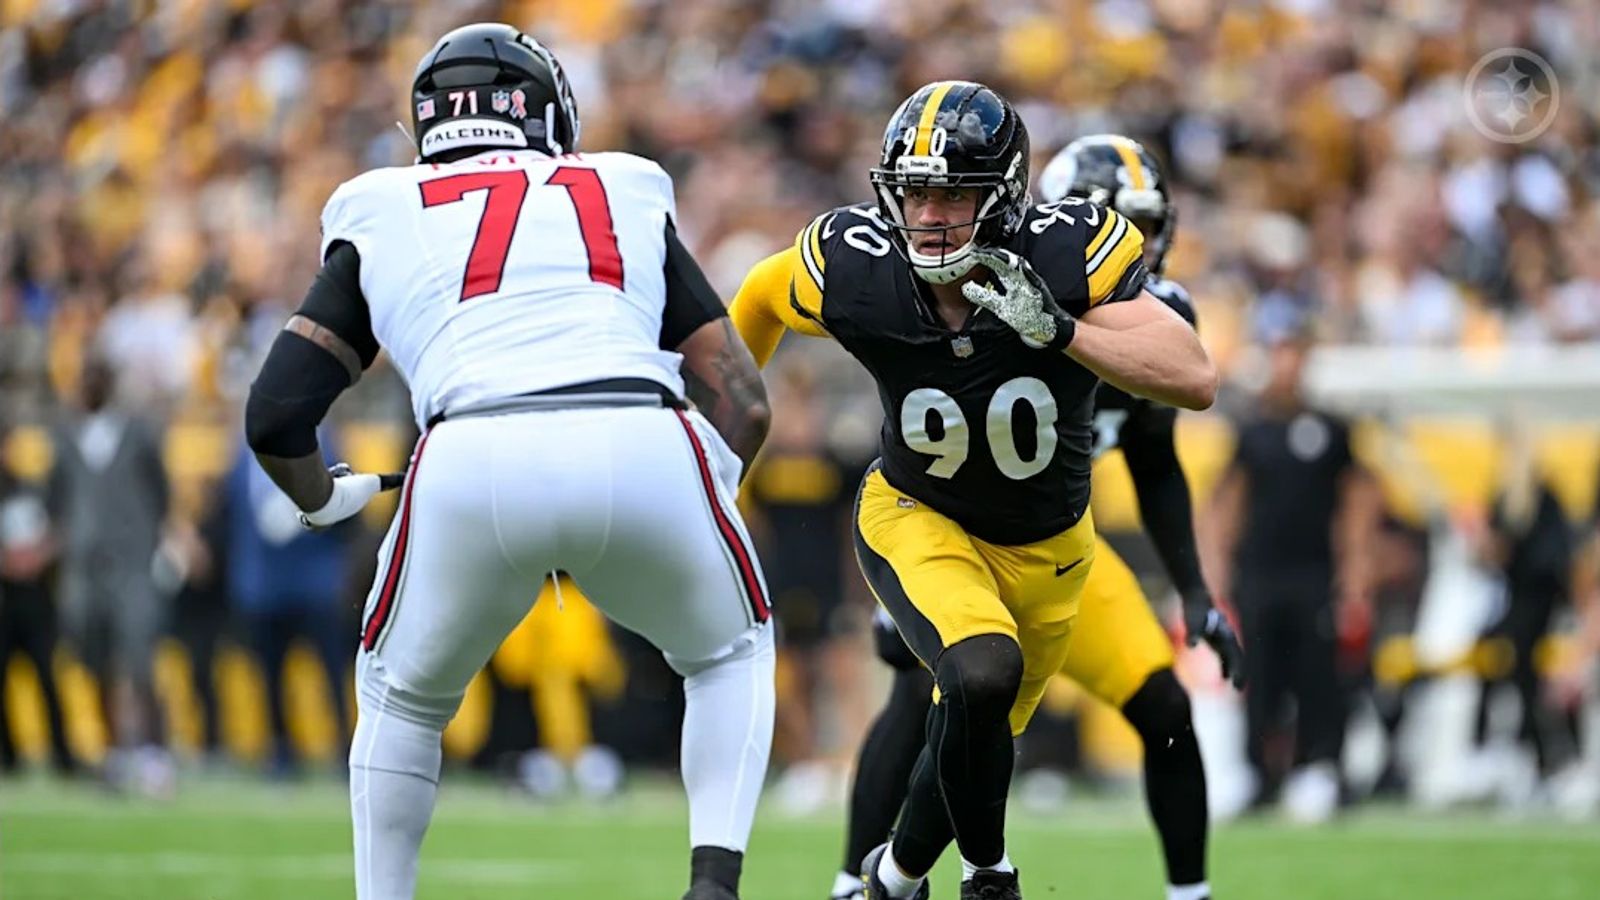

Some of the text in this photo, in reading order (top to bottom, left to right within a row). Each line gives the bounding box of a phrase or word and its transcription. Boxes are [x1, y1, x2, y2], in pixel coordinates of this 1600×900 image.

[449, 91, 478, 117] 71
[426, 128, 515, 146] FALCONS
[903, 127, 947, 156] 90
[418, 166, 625, 303] 71
[901, 376, 1059, 480] 90
